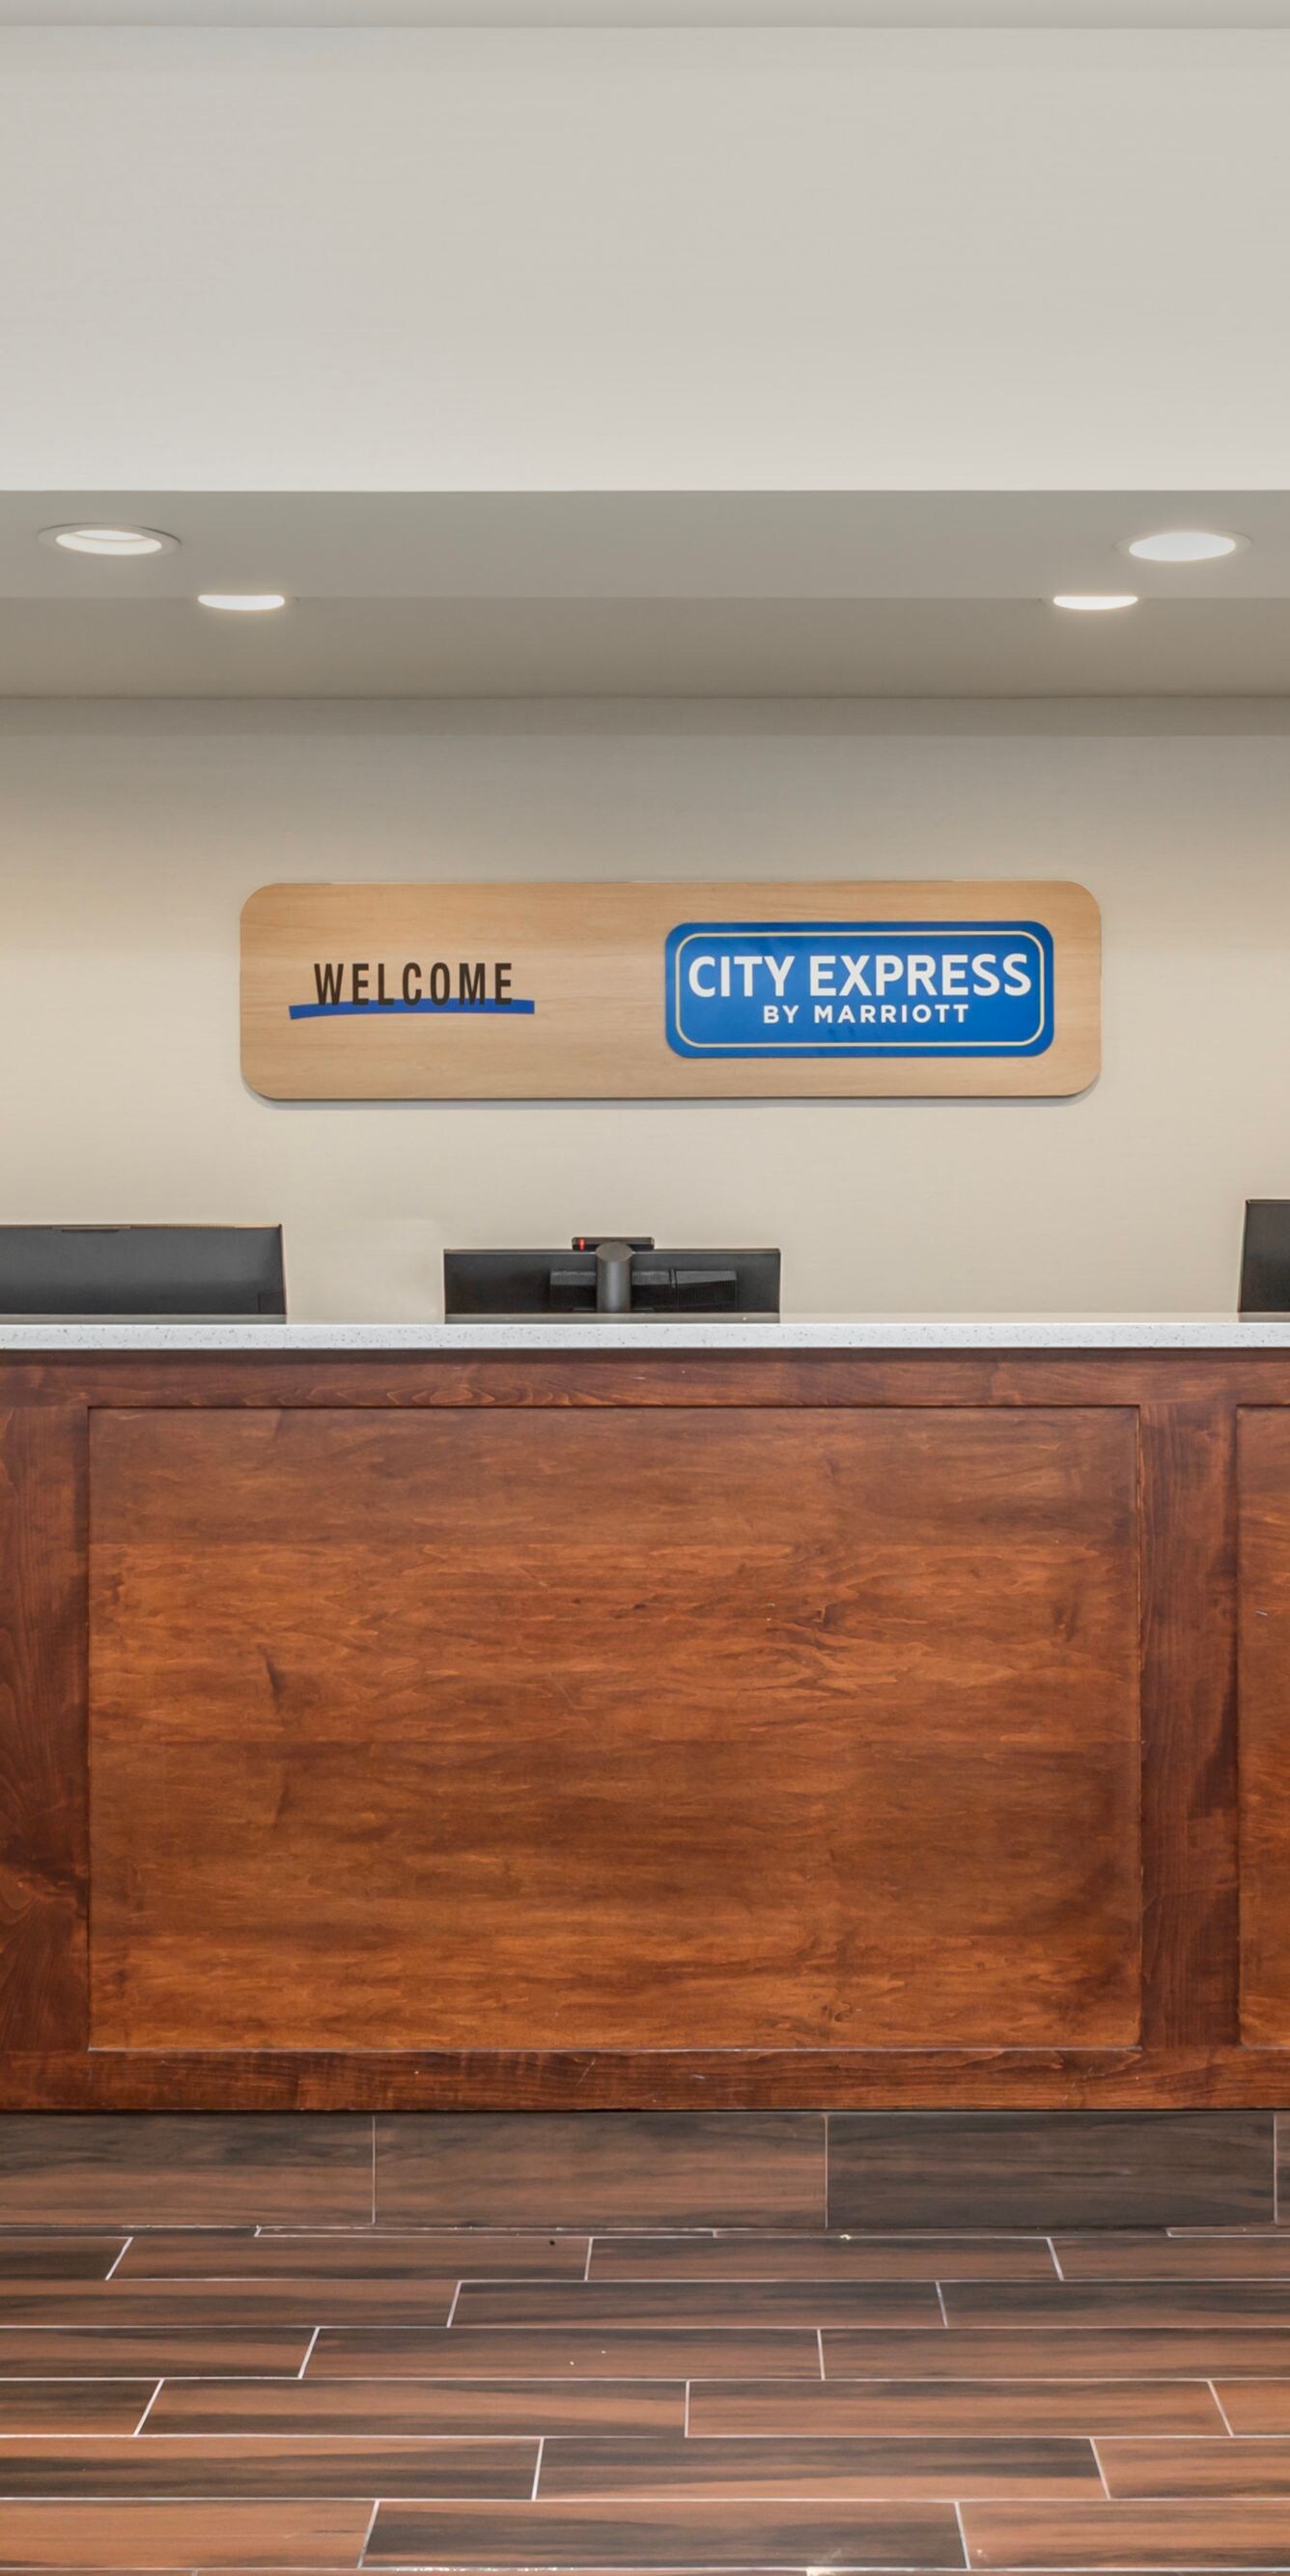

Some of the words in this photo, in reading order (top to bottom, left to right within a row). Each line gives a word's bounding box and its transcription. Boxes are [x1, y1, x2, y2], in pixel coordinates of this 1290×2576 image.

[314, 962, 513, 1006] WELCOME
[688, 955, 796, 998] CITY
[809, 953, 1031, 997] EXPRESS
[763, 1005, 799, 1024] BY
[814, 1004, 969, 1024] MARRIOTT
